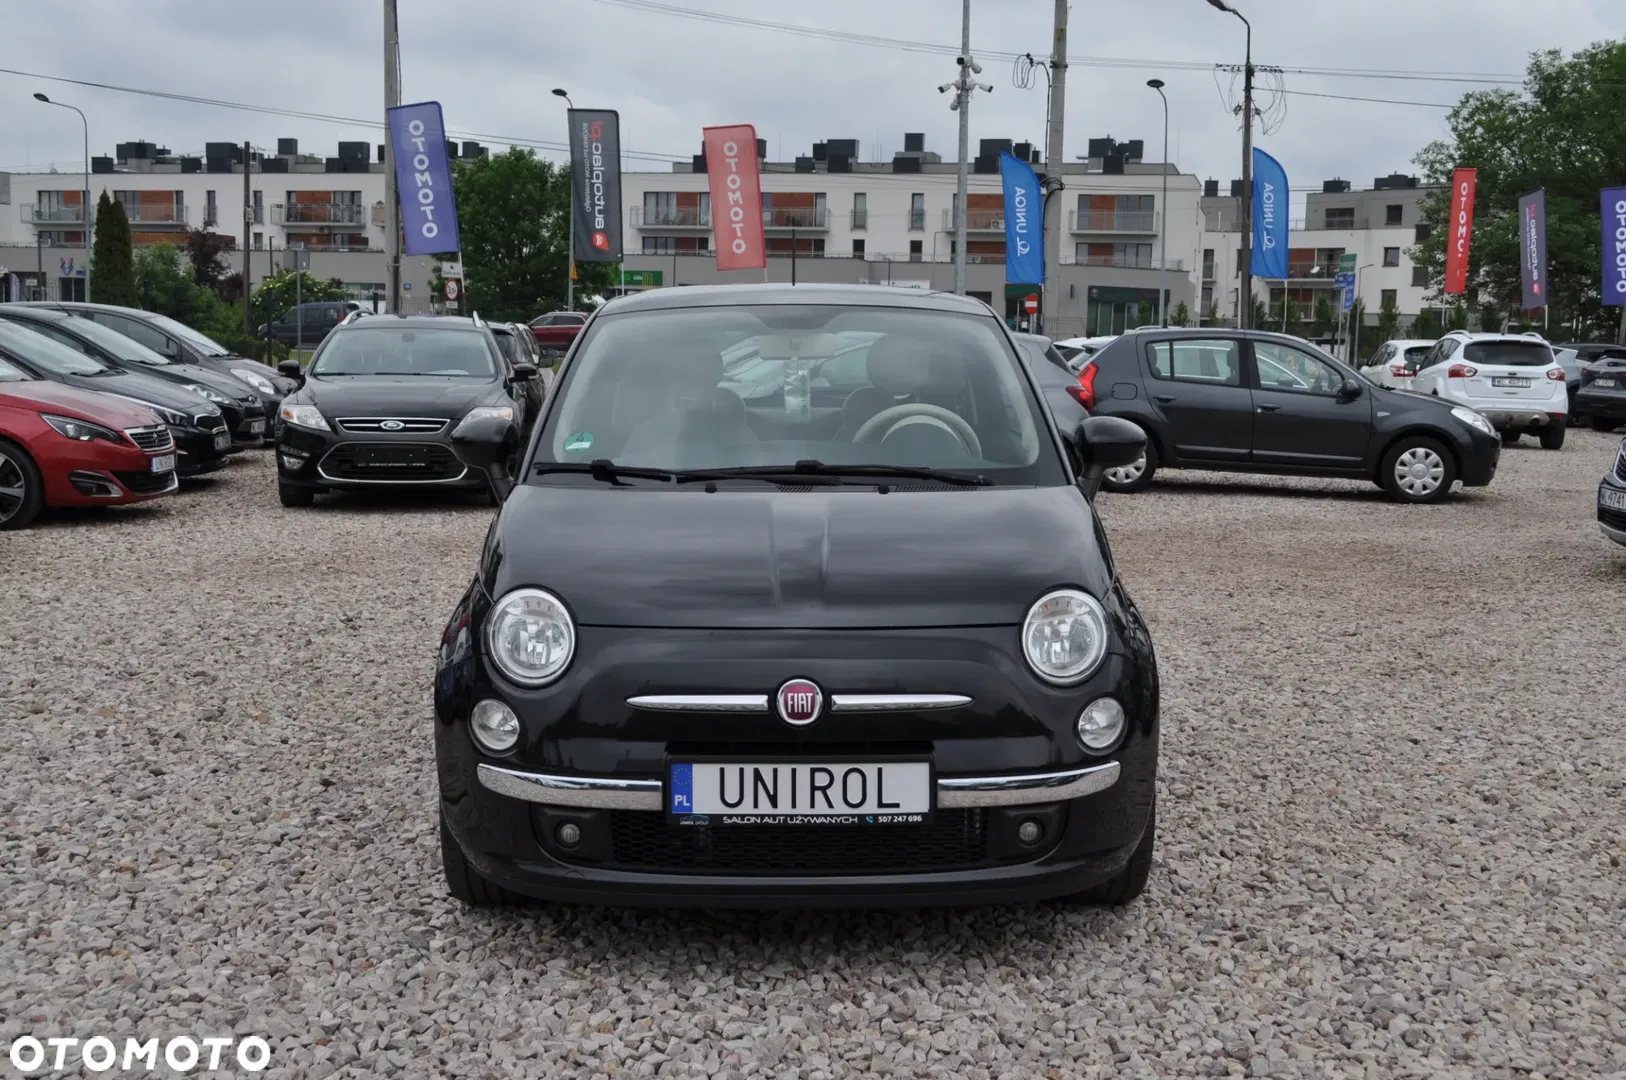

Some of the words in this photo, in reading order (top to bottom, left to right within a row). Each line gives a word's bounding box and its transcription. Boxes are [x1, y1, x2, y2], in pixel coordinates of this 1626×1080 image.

[408, 119, 438, 238] OTOMOTO
[722, 141, 746, 254] OTOMOTO
[787, 692, 813, 713] FIAT
[674, 794, 690, 807] PL
[719, 767, 900, 809] UNIROL
[723, 816, 760, 824] SALON
[762, 816, 785, 824] AUT
[787, 815, 858, 824] UŻYWANYCH
